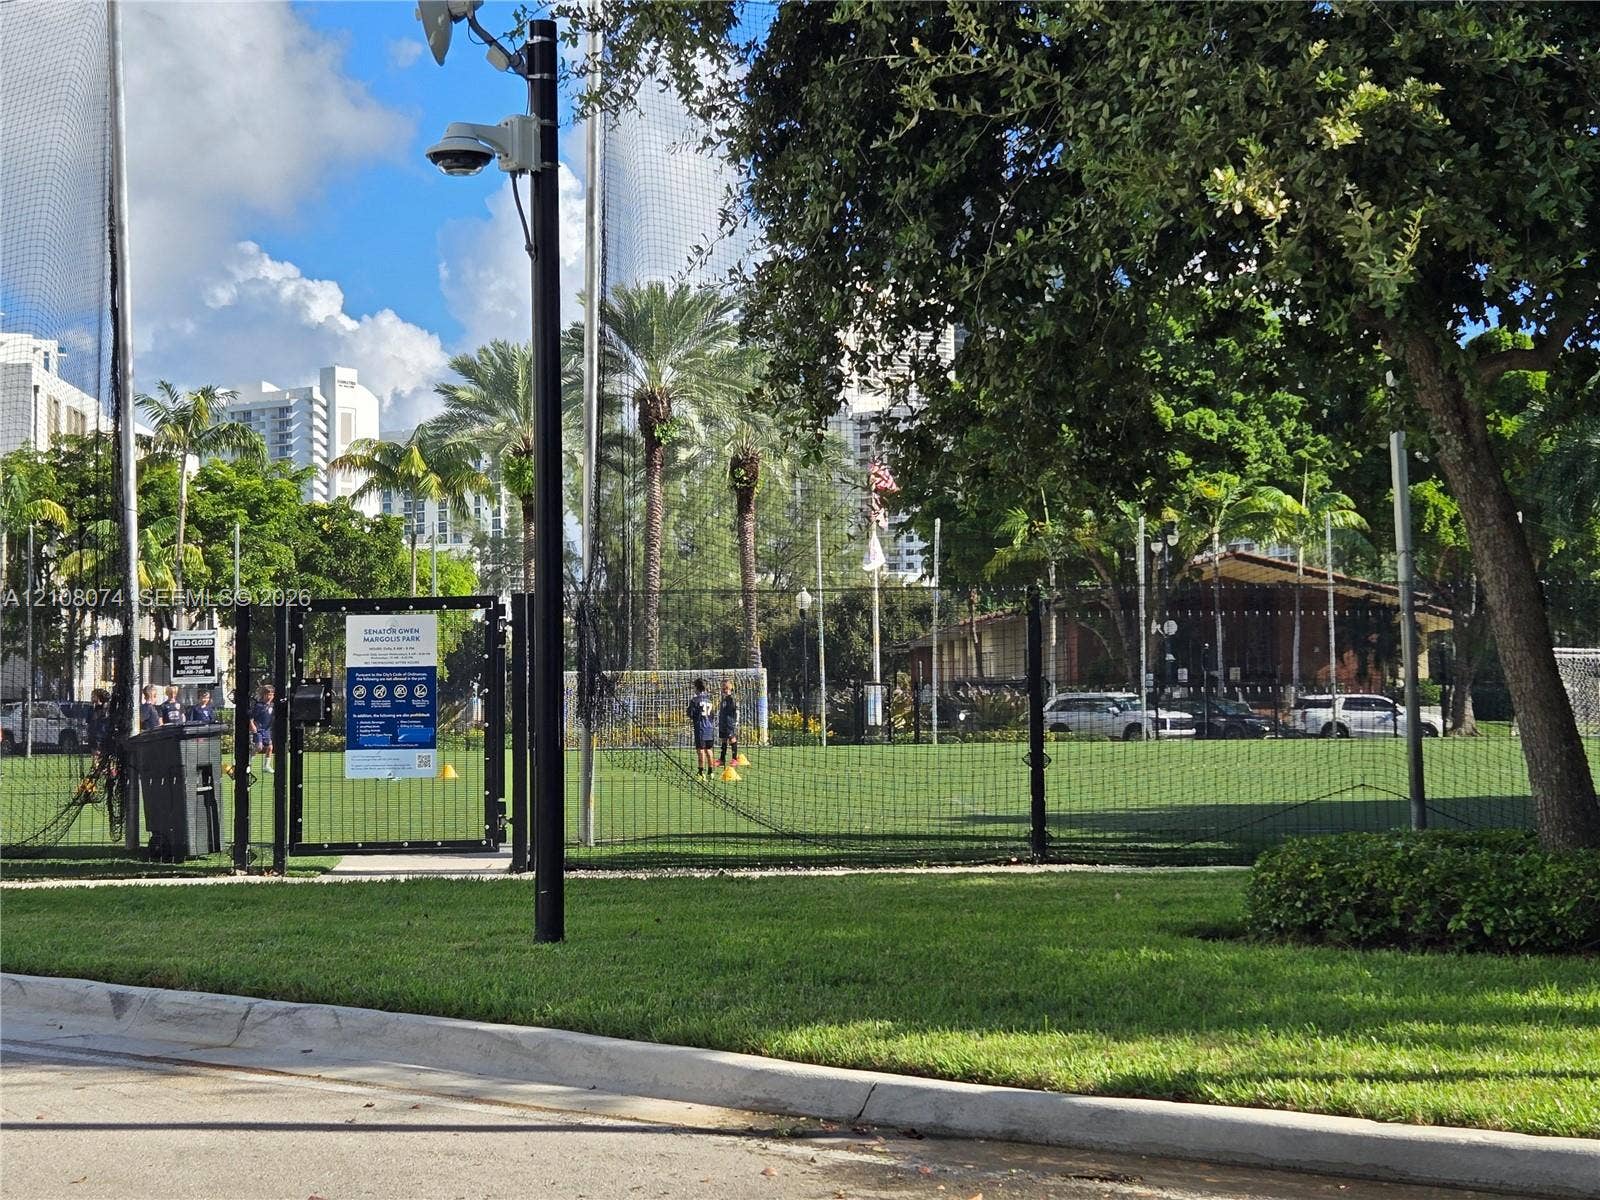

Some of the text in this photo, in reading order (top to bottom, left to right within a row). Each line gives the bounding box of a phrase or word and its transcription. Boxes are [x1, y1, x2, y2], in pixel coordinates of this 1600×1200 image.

[363, 627, 397, 635] SENATOR
[363, 635, 401, 643] MARGOLIS
[700, 702, 713, 716] 37
